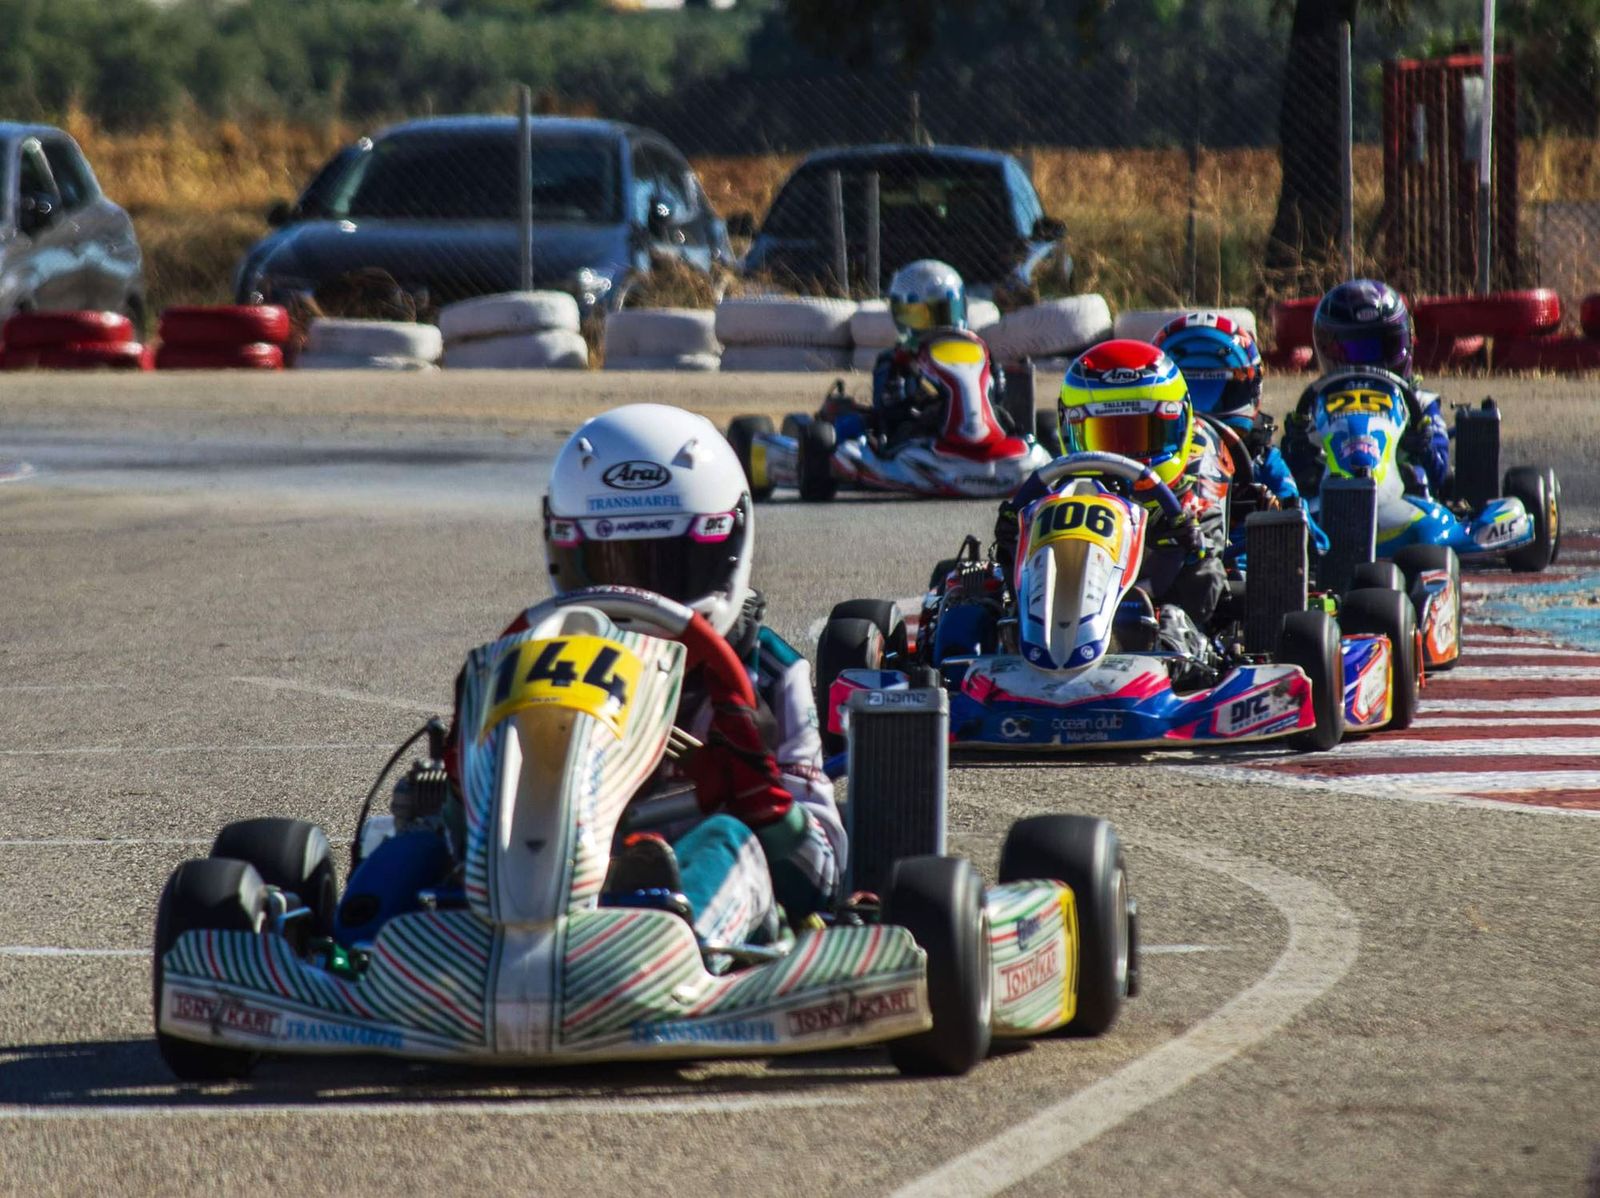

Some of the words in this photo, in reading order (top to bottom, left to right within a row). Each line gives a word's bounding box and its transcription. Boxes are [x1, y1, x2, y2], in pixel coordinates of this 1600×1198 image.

[1108, 367, 1140, 380] Arai
[611, 463, 663, 481] Arai
[1037, 501, 1116, 538] 106
[494, 641, 628, 706] 144
